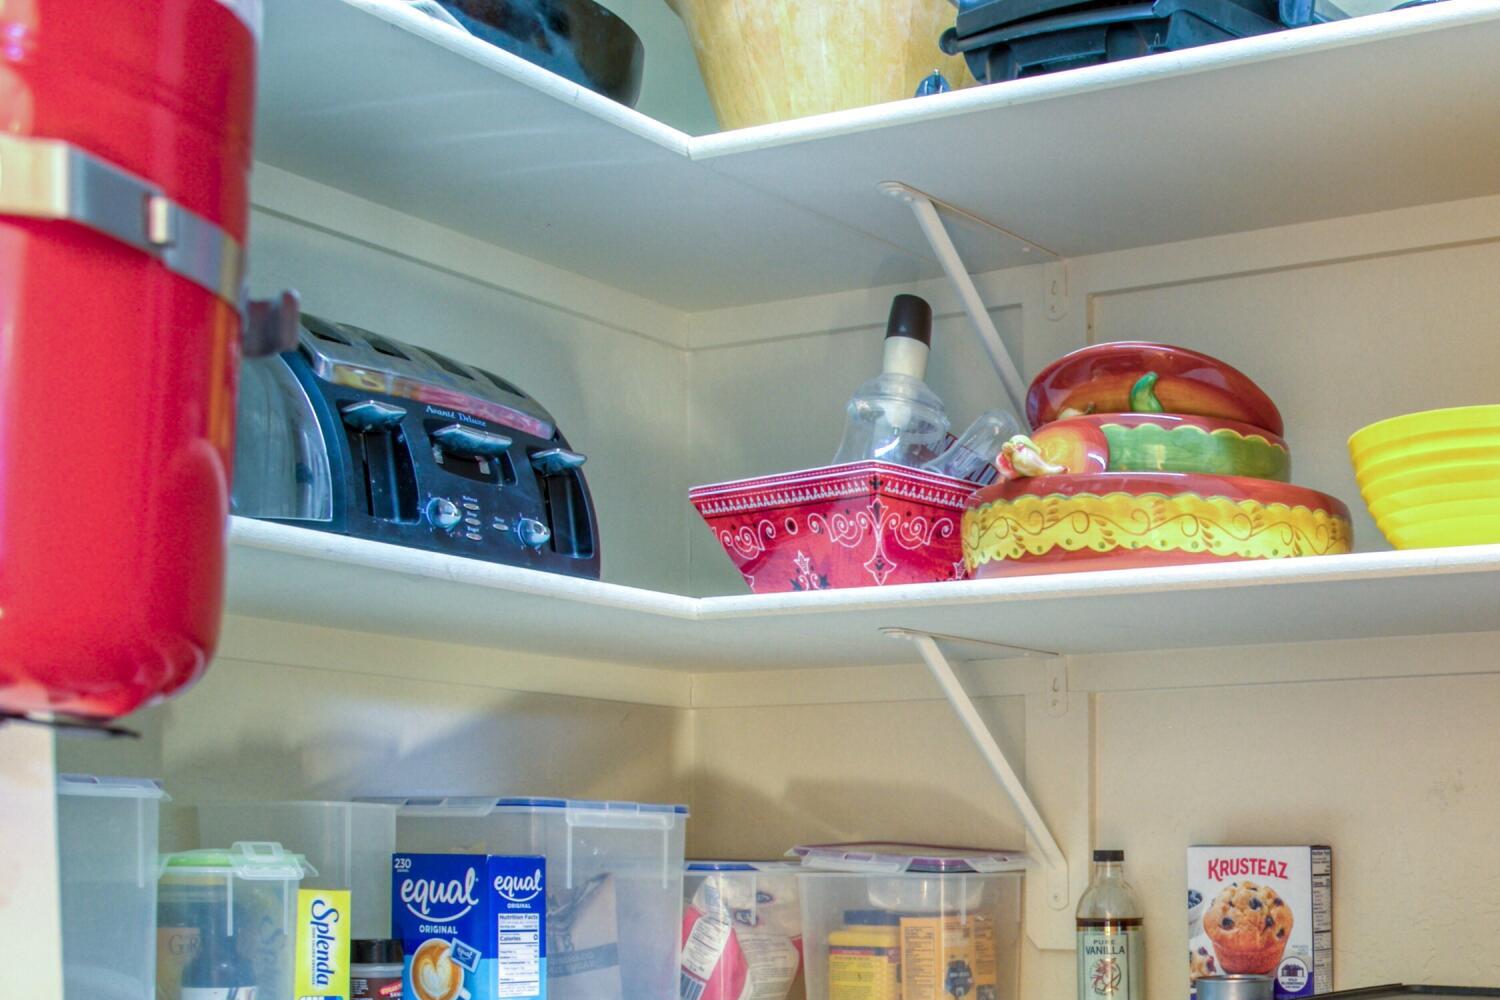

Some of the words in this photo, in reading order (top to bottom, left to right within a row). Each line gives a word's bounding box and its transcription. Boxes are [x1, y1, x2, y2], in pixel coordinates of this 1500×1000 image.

[394, 858, 411, 869] 230
[1208, 858, 1288, 881] KRUSTEAZ
[401, 867, 479, 914] equal
[494, 869, 543, 897] equal
[419, 924, 459, 935] ORIGINAL
[310, 899, 340, 986] Splenda
[1085, 946, 1126, 955] VANILLA
